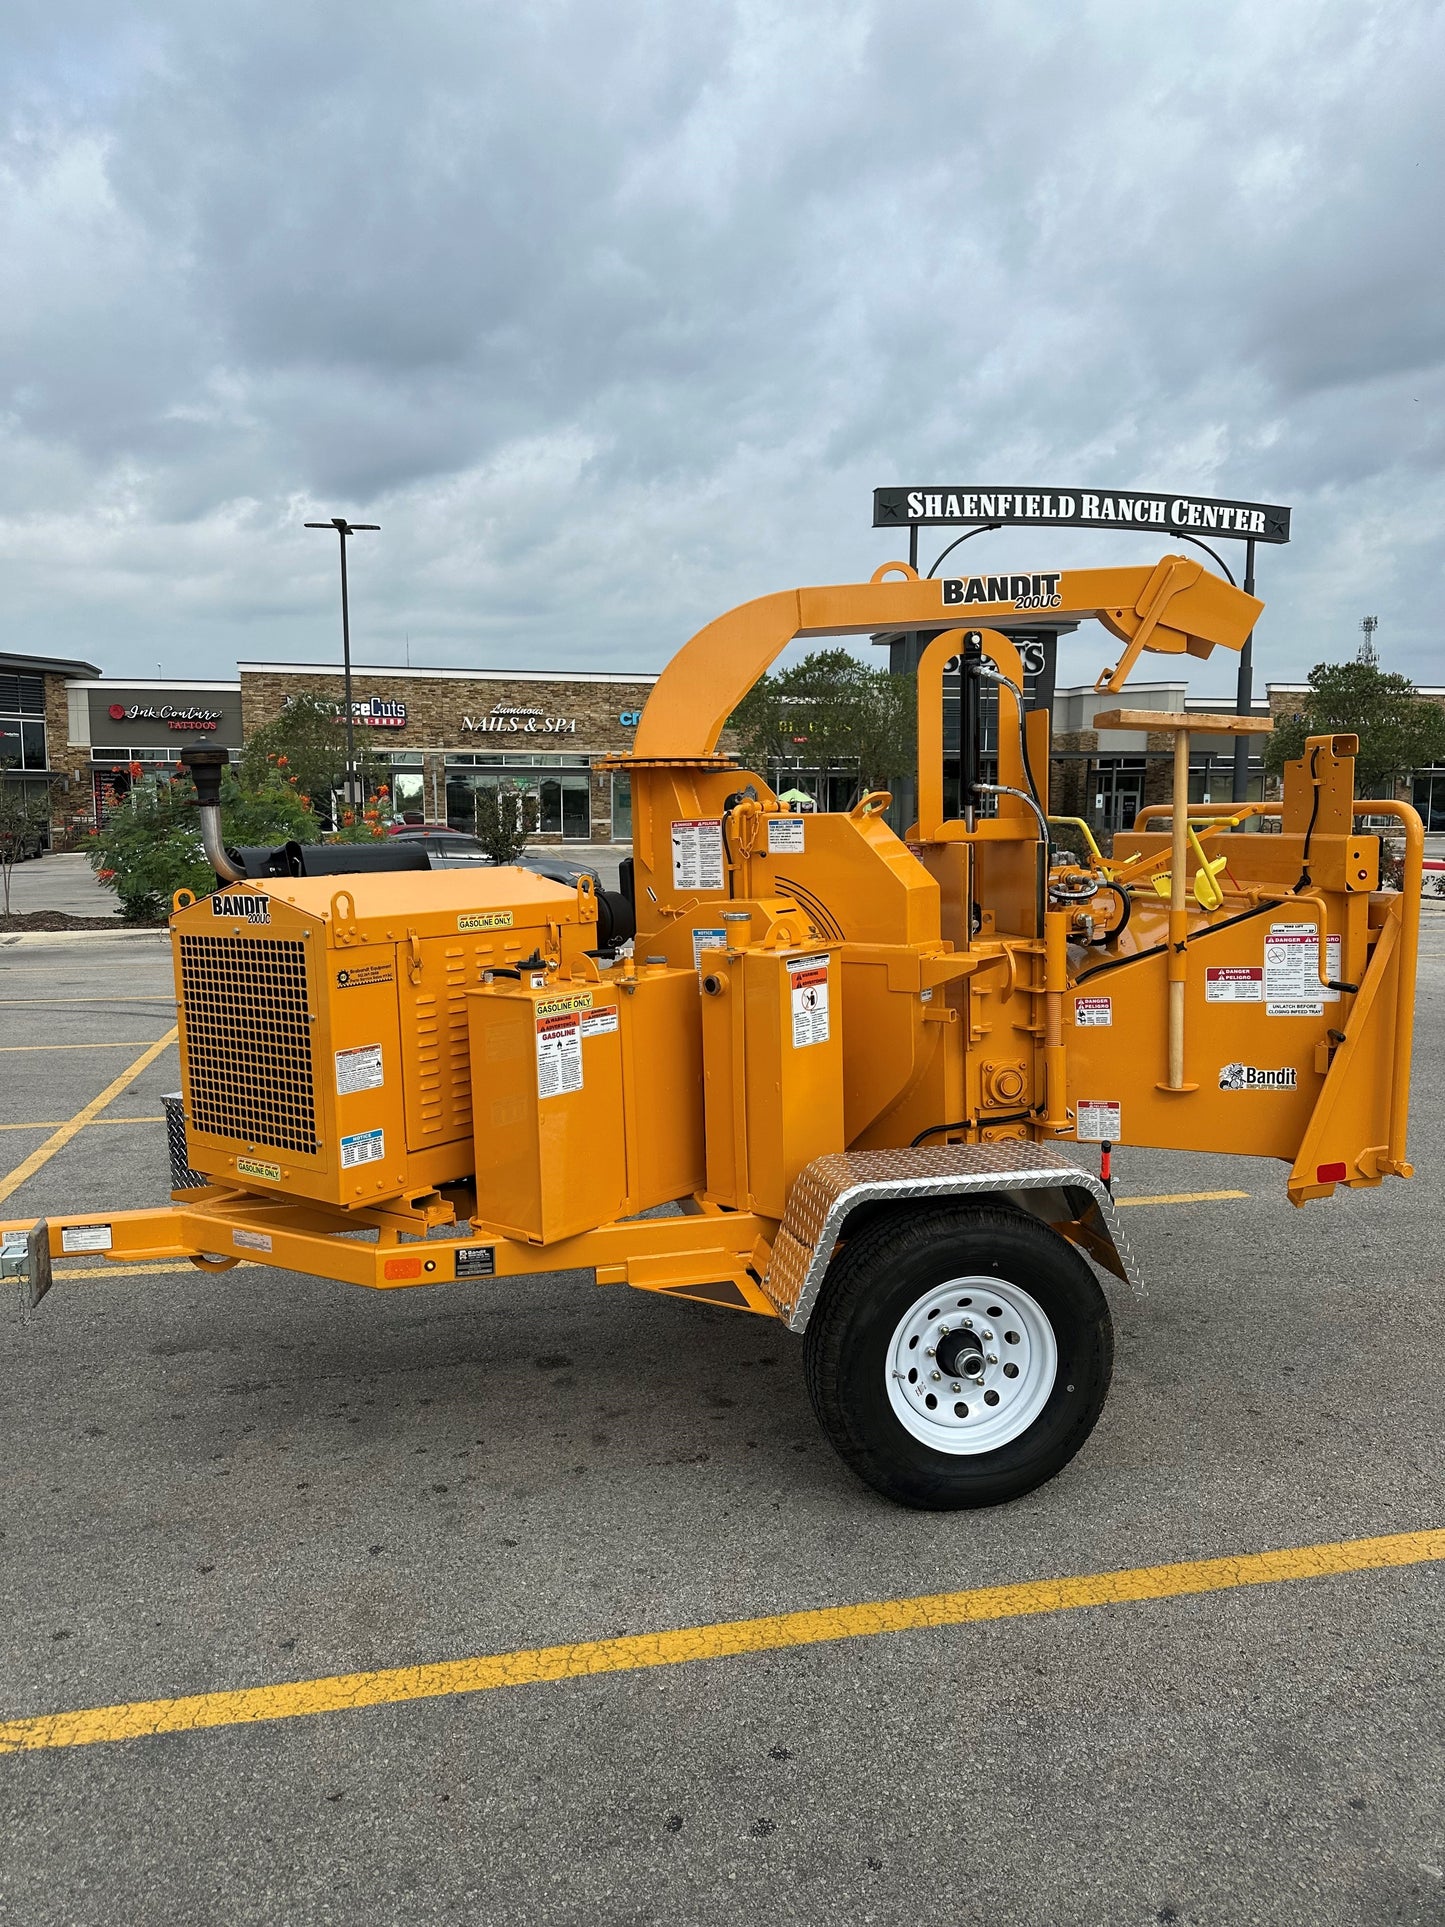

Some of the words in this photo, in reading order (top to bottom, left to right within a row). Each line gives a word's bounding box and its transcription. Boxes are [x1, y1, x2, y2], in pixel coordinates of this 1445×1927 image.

[907, 491, 1076, 518] SHAENFIELD
[1080, 493, 1167, 524] RANCH
[1170, 498, 1266, 534] CENTER
[943, 573, 1060, 605] BANDIT
[1014, 595, 1061, 609] 200UC
[127, 704, 159, 719] Ink
[160, 704, 222, 720] Couture
[489, 703, 544, 715] Luminous
[461, 716, 520, 732] NAILS
[523, 717, 537, 732] &
[542, 717, 576, 733] SPA
[619, 712, 642, 726] cr
[212, 896, 269, 916] BANDIT
[248, 914, 270, 924] 200UC
[460, 918, 493, 929] GASOLINE
[494, 917, 511, 926] ONLY
[537, 1001, 572, 1014] GASOLINE
[573, 998, 591, 1009] ONLY
[546, 1021, 577, 1031] ADVERTENCIA
[551, 1015, 571, 1023] WARNING
[542, 1028, 576, 1041] GASOLINE
[1246, 1067, 1296, 1084] Bandit
[352, 1133, 372, 1142] NOTICE
[238, 1163, 264, 1175] GASOLINE
[264, 1168, 279, 1179] ONLY
